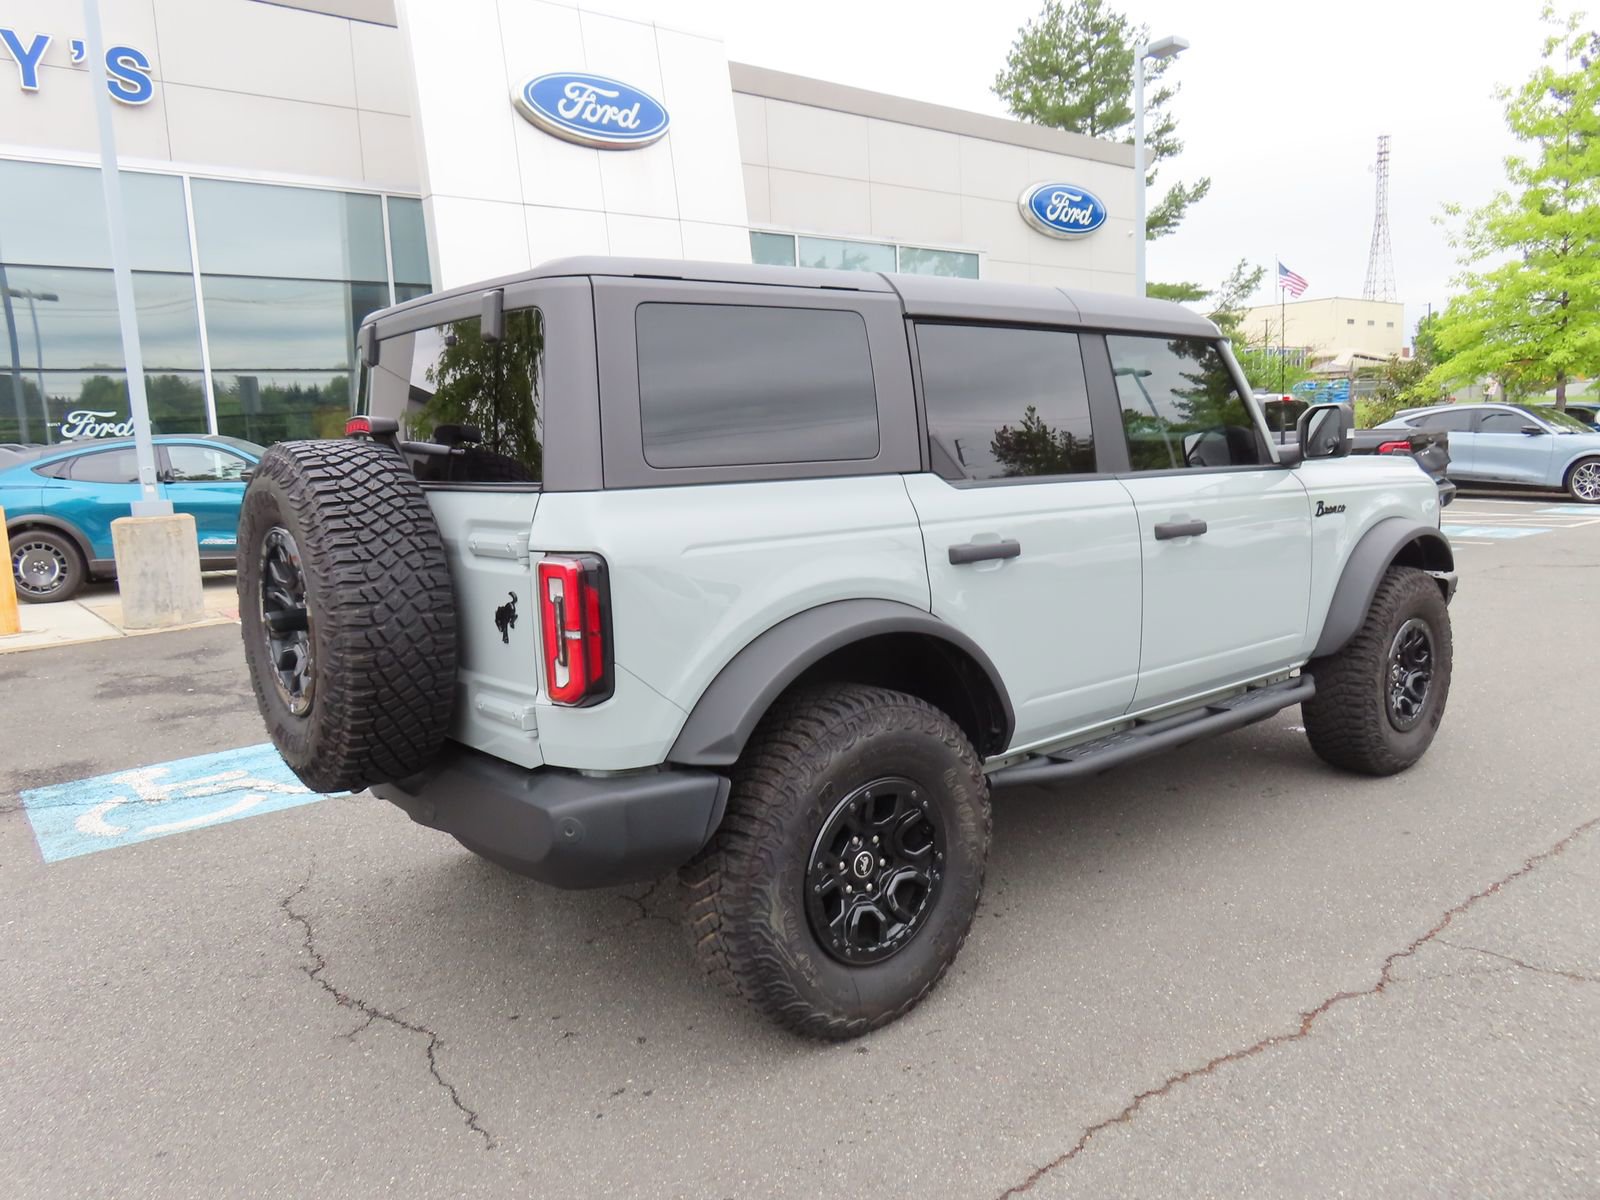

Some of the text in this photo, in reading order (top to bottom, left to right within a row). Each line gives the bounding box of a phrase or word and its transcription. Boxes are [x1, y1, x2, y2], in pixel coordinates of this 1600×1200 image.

[0, 28, 155, 105] Y'S
[557, 81, 641, 130] Ford
[1046, 191, 1094, 225] Ford
[61, 410, 136, 438] Ford
[1315, 500, 1346, 518] Bronco
